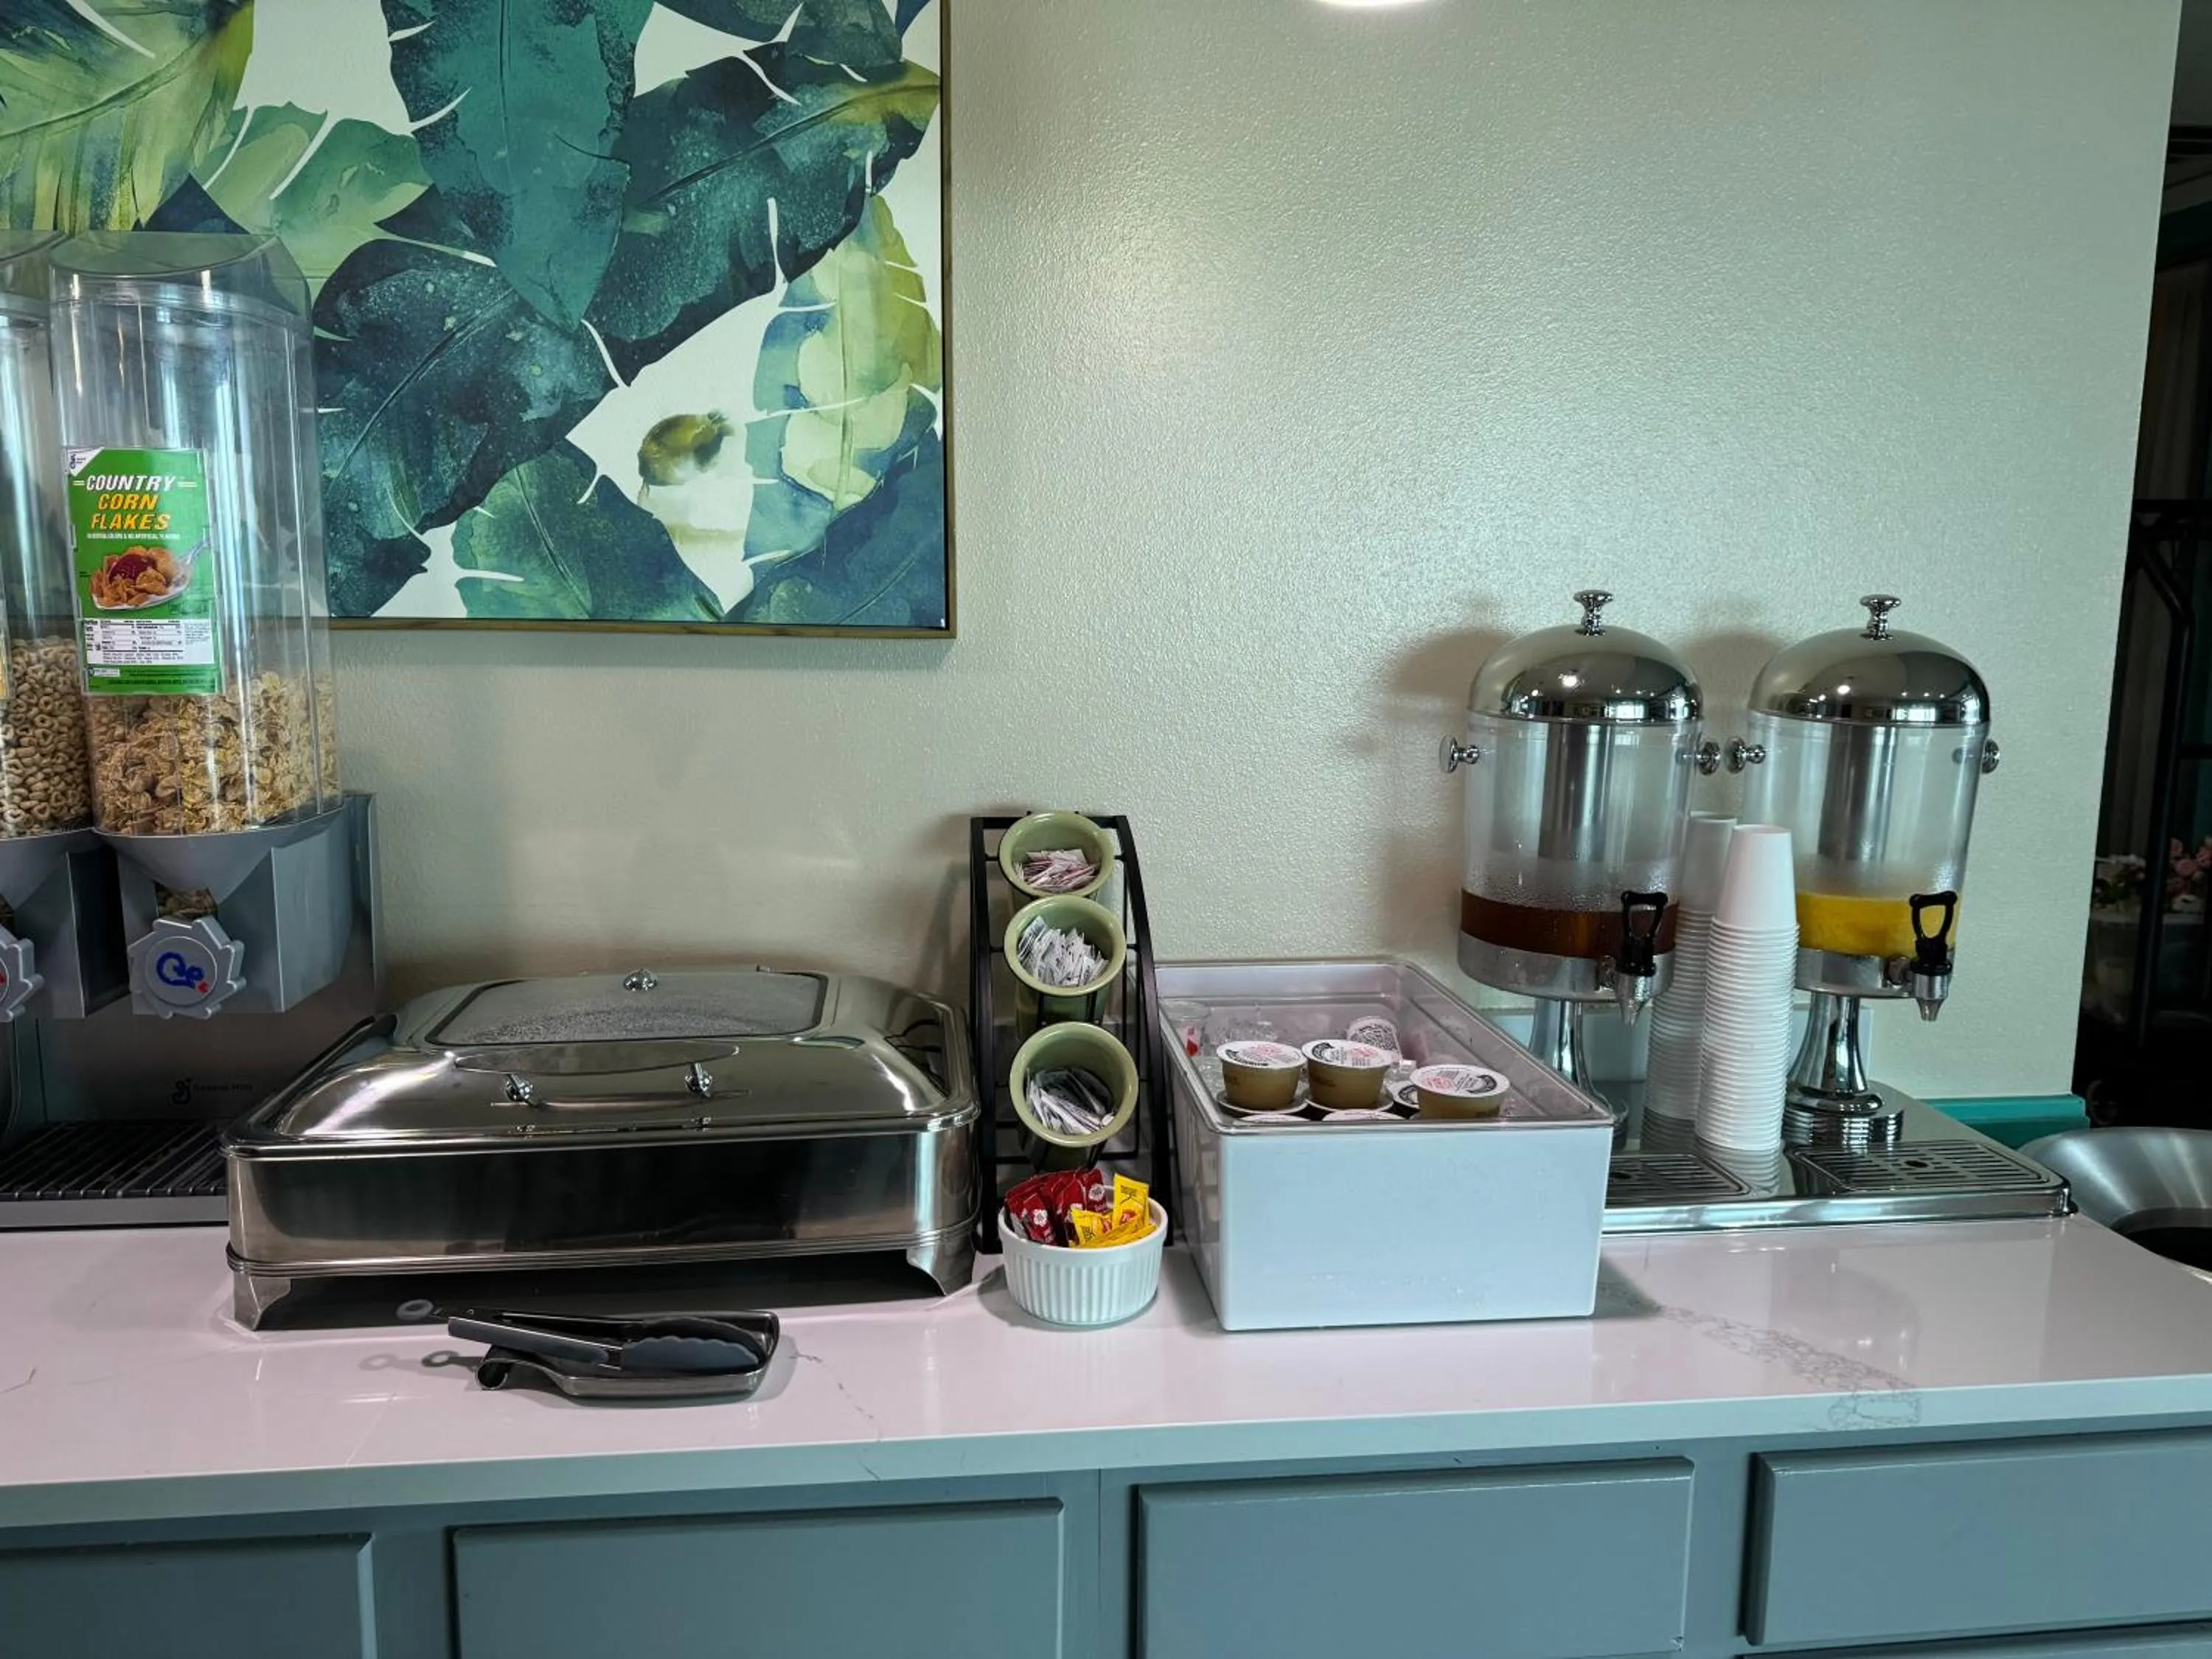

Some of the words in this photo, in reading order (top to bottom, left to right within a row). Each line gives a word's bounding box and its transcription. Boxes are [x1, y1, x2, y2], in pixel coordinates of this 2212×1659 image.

[86, 474, 175, 491] COUNTRY
[97, 493, 159, 510] CORN
[90, 513, 171, 530] FLAKES
